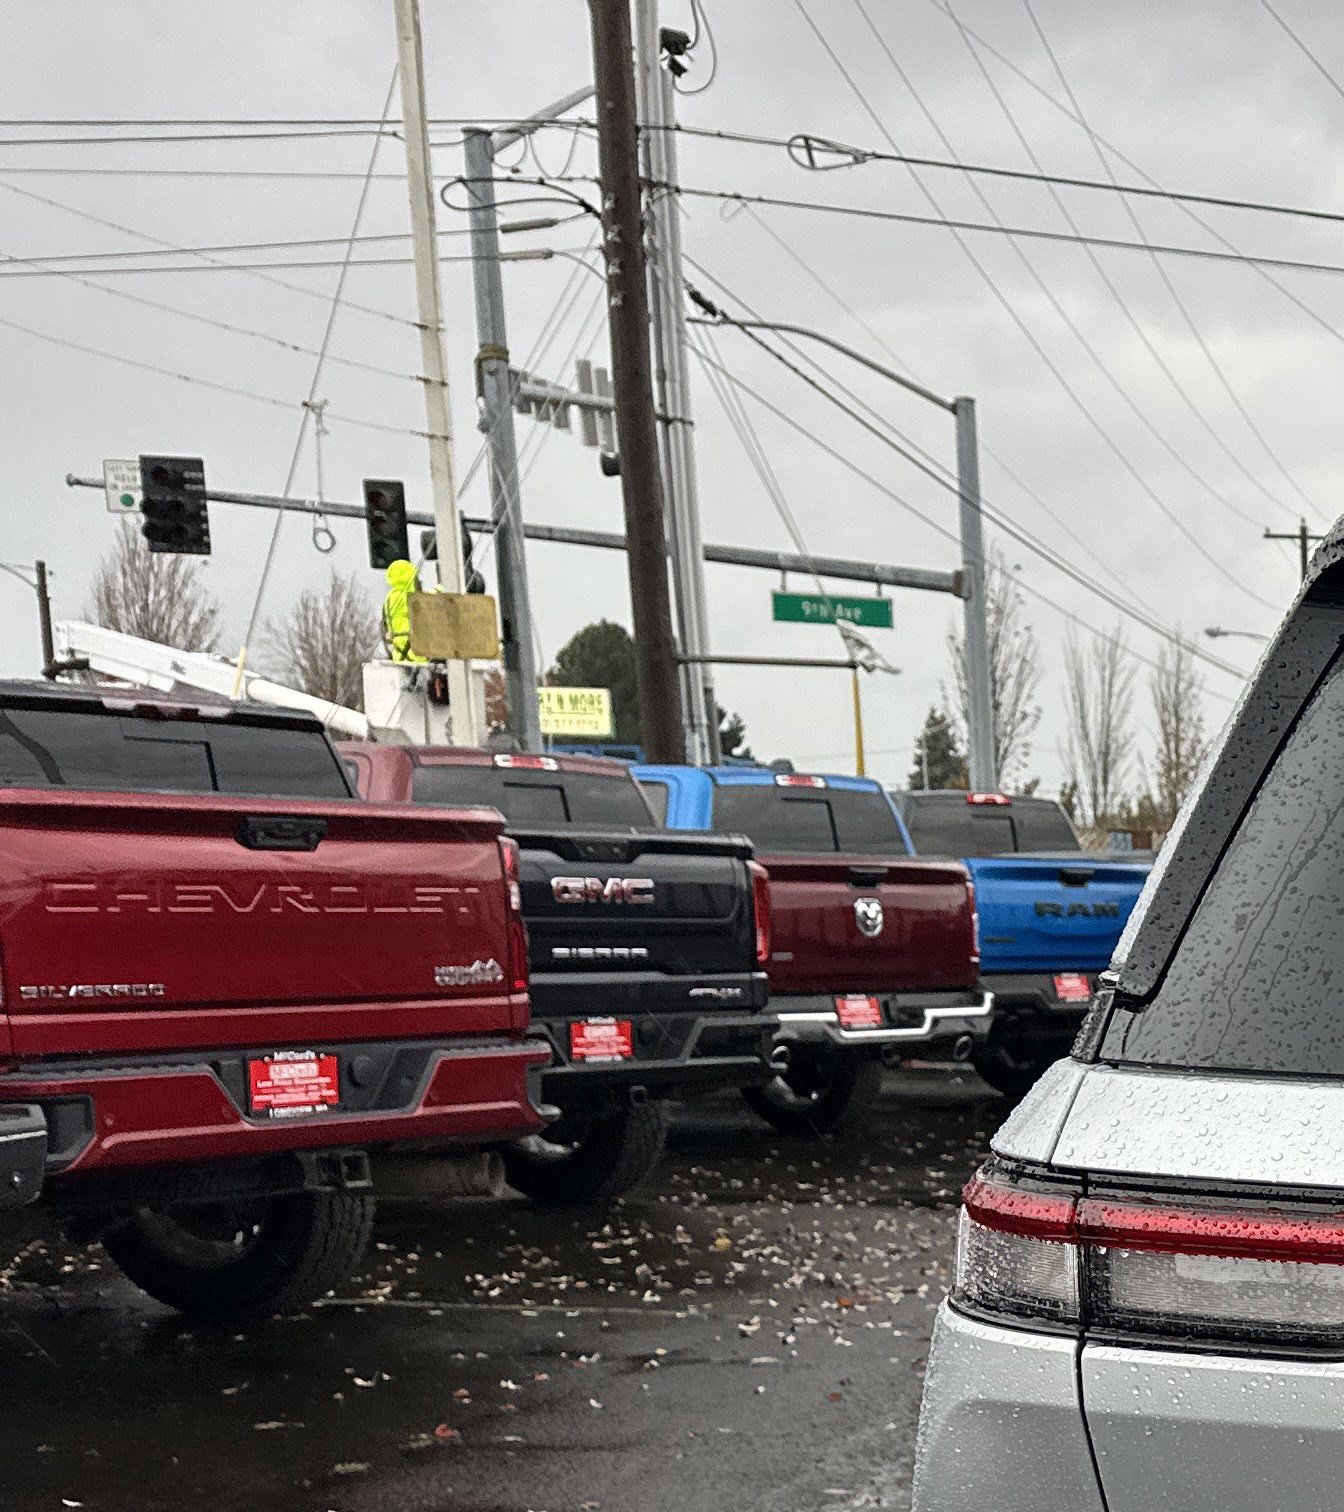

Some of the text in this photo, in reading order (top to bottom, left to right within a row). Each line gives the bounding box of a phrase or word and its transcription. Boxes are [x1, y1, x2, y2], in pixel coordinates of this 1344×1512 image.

[801, 600, 862, 619] 9th Ave
[45, 883, 481, 913] CHEVROLET
[550, 876, 655, 904] GMC
[1034, 901, 1120, 918] RAM
[551, 947, 649, 959] SIERRA
[20, 984, 165, 999] SILVERADO
